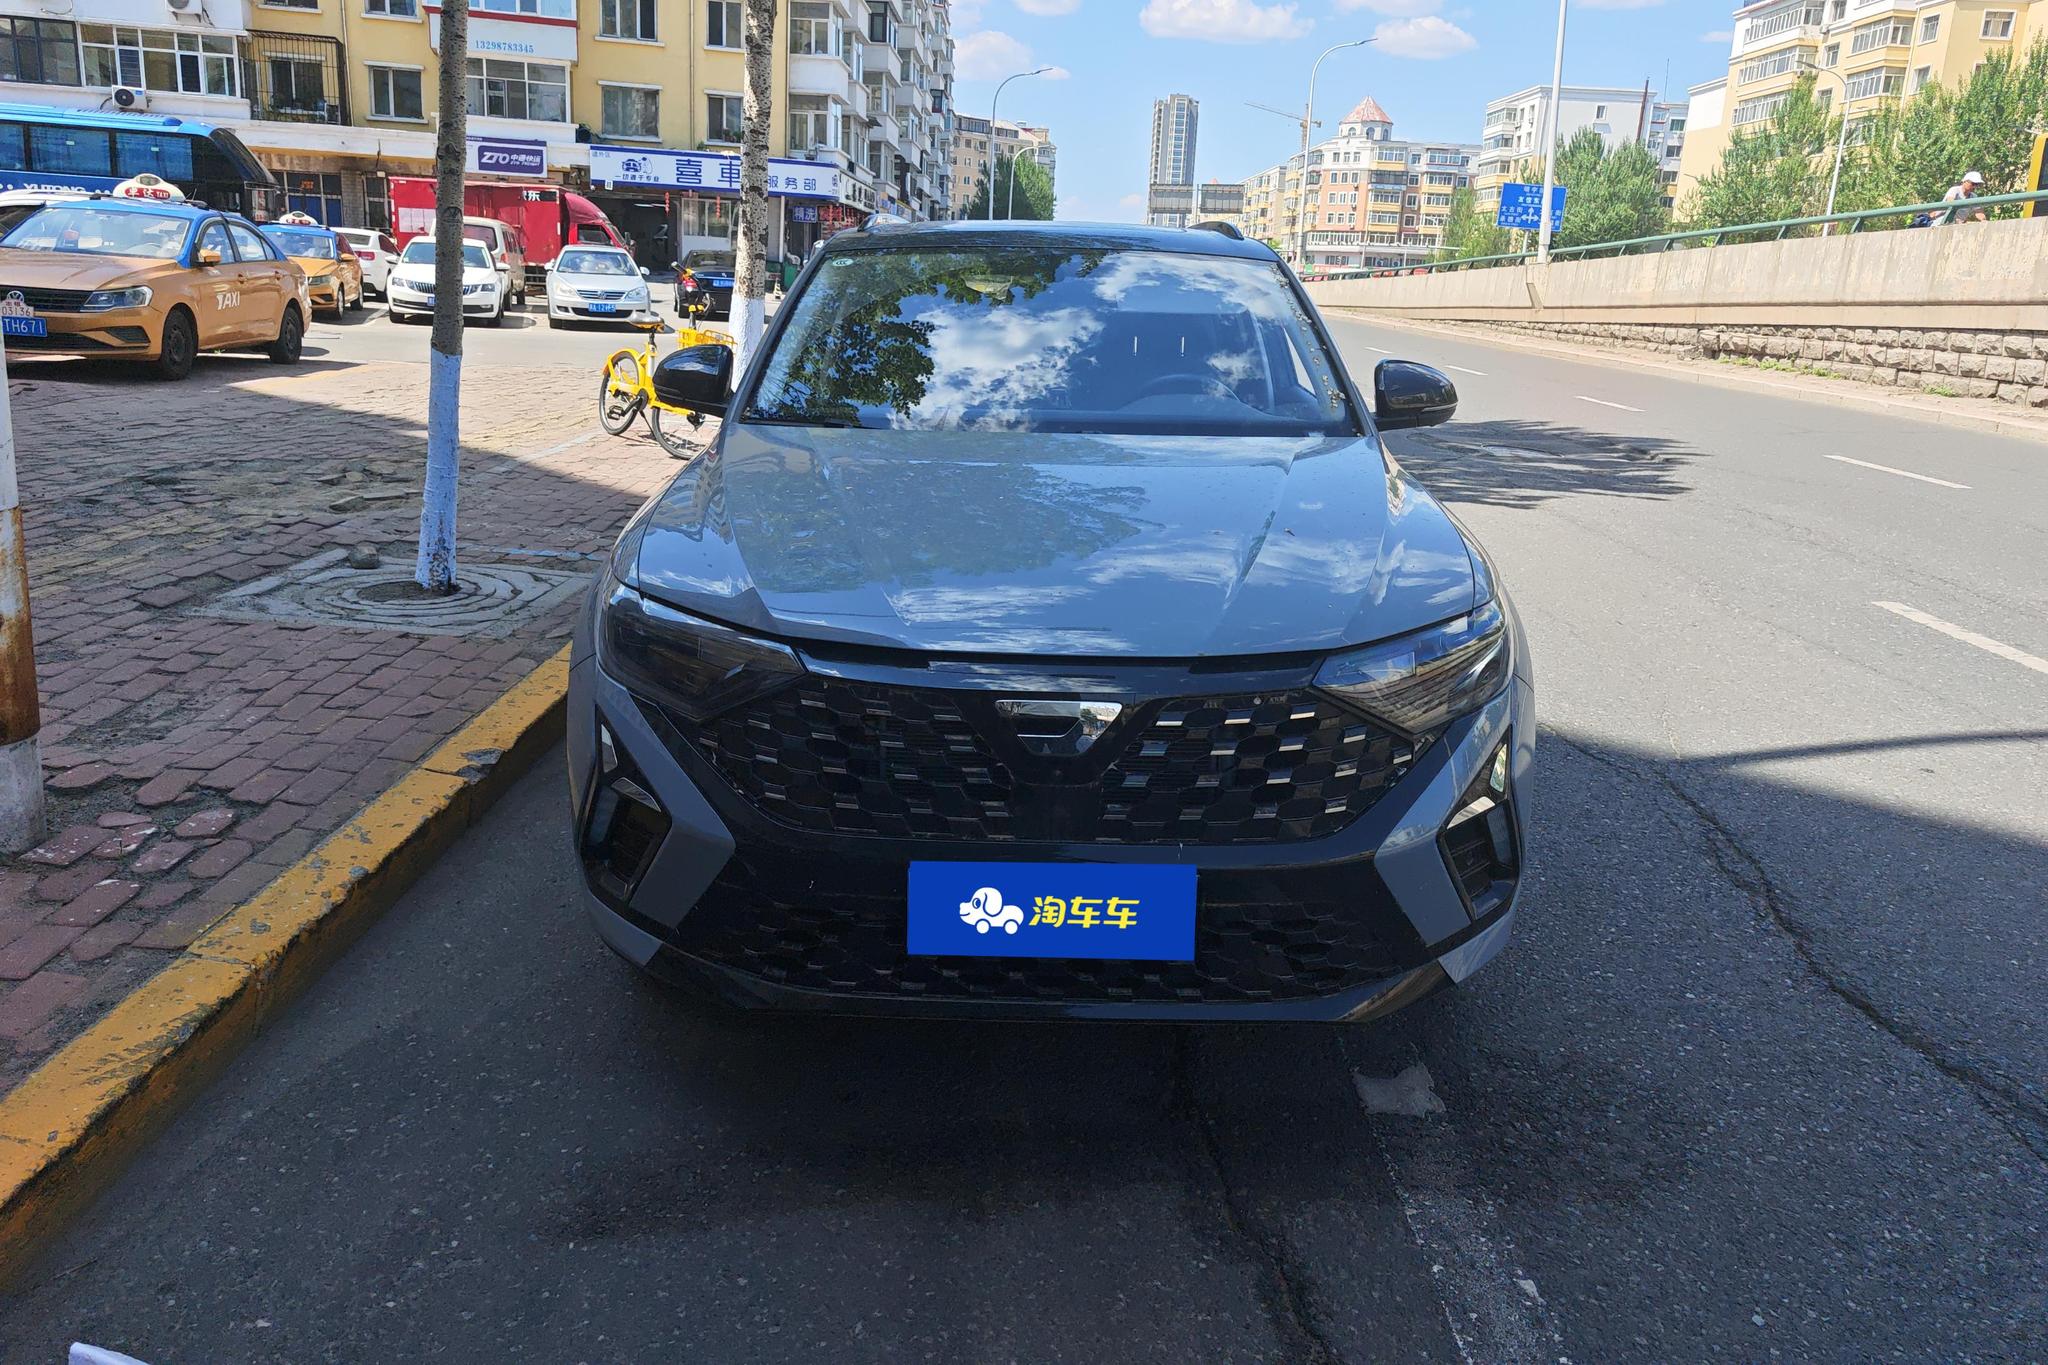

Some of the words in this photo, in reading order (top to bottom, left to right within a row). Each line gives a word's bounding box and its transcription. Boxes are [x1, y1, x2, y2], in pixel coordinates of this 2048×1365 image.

[475, 40, 534, 54] 13298783345
[480, 151, 510, 165] ZTO
[216, 291, 240, 311] TAXI
[2, 306, 31, 317] 03136
[3, 318, 43, 335] TH671
